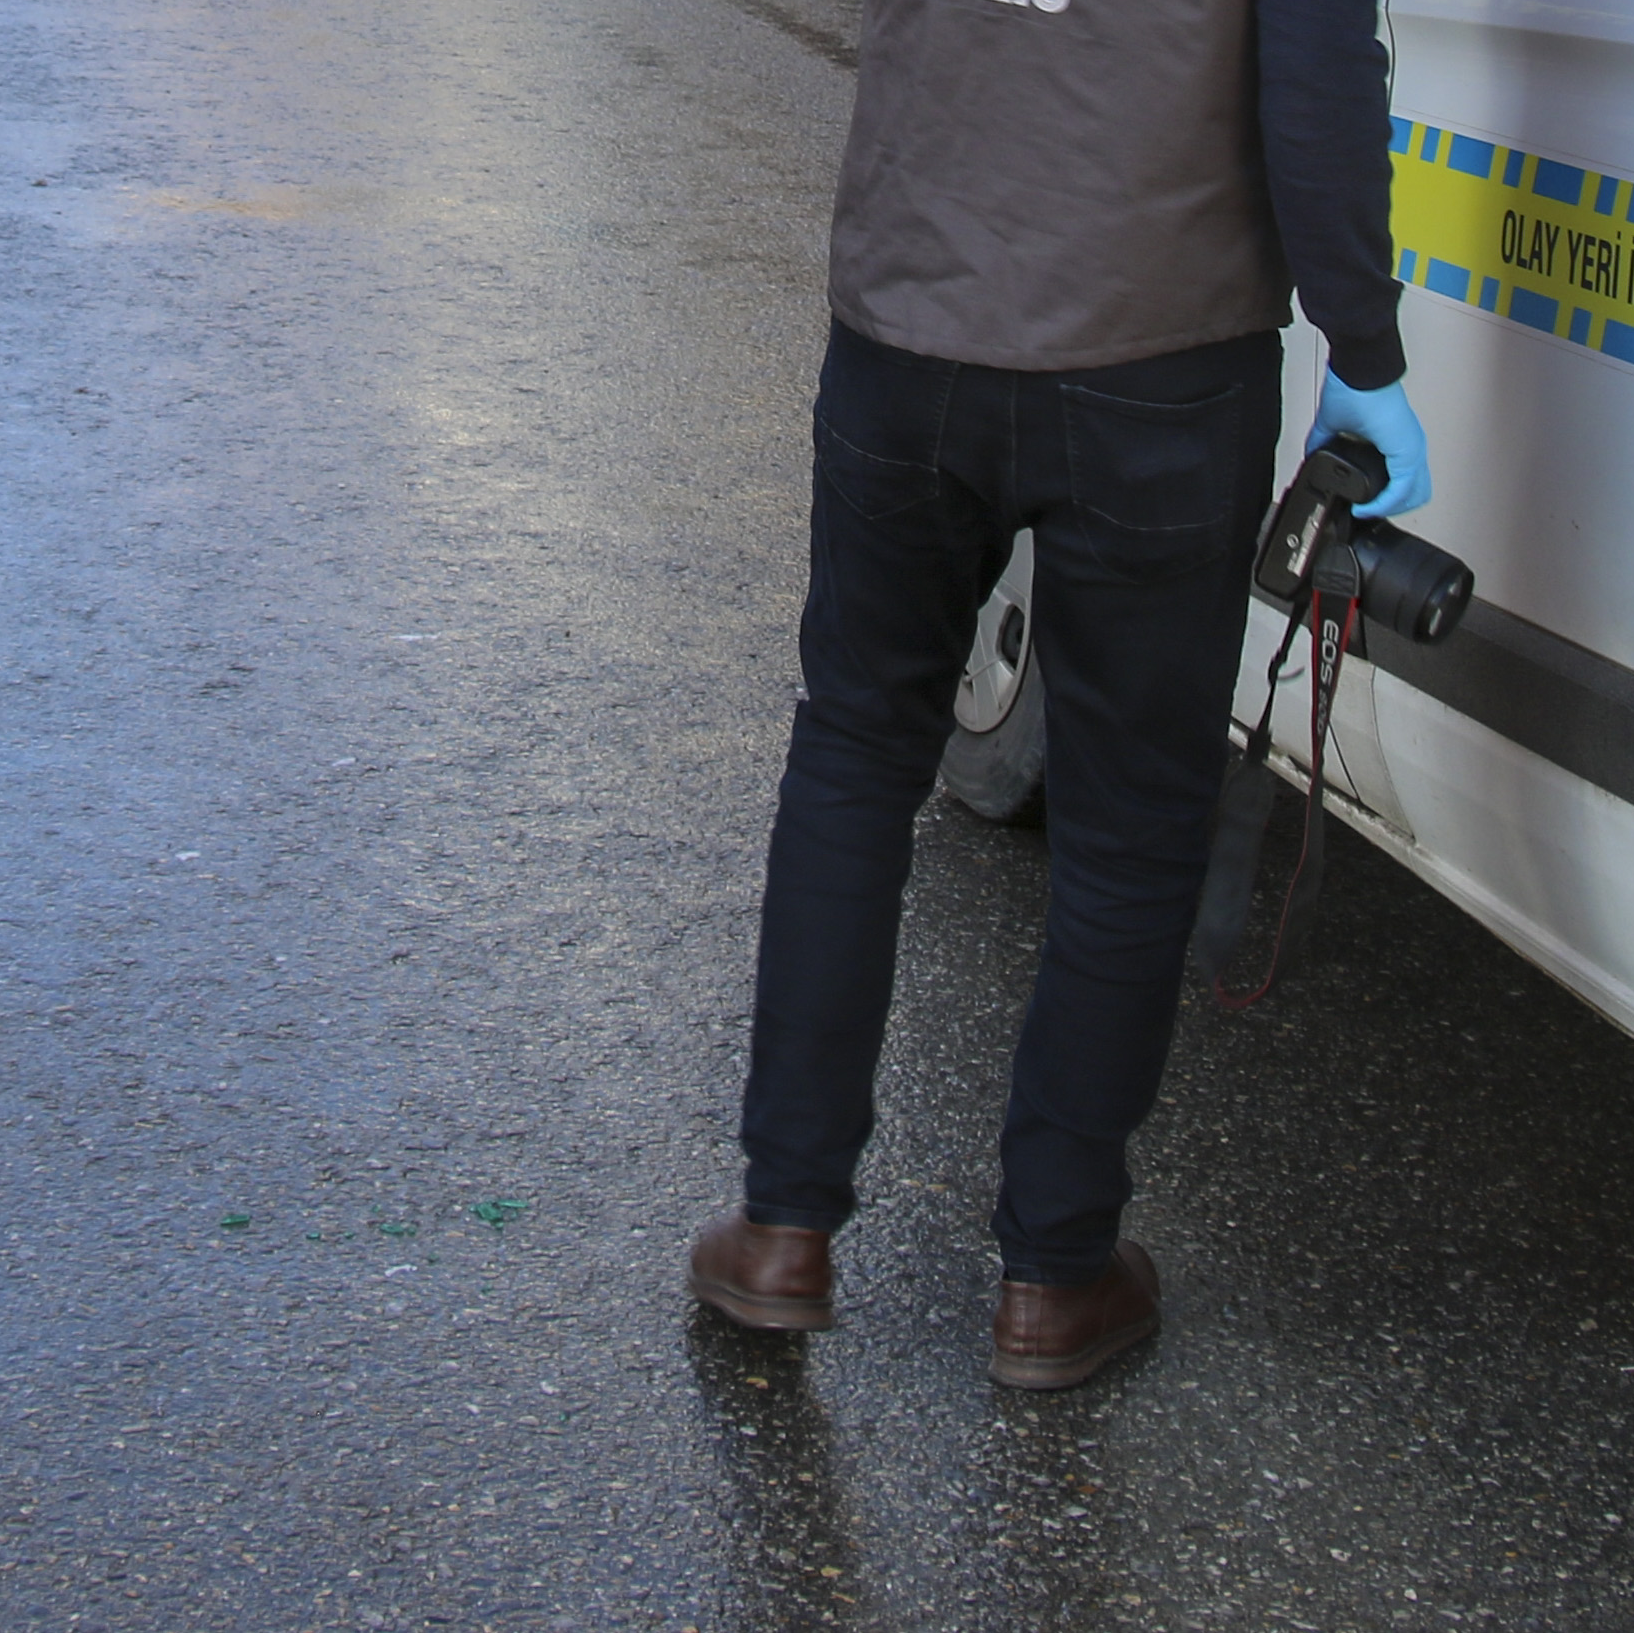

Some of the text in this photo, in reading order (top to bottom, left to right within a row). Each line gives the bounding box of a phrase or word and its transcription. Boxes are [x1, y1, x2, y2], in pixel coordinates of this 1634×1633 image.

[1501, 209, 1560, 276] OLAY
[1567, 230, 1621, 301] YERİ
[1320, 618, 1340, 686] EOS
